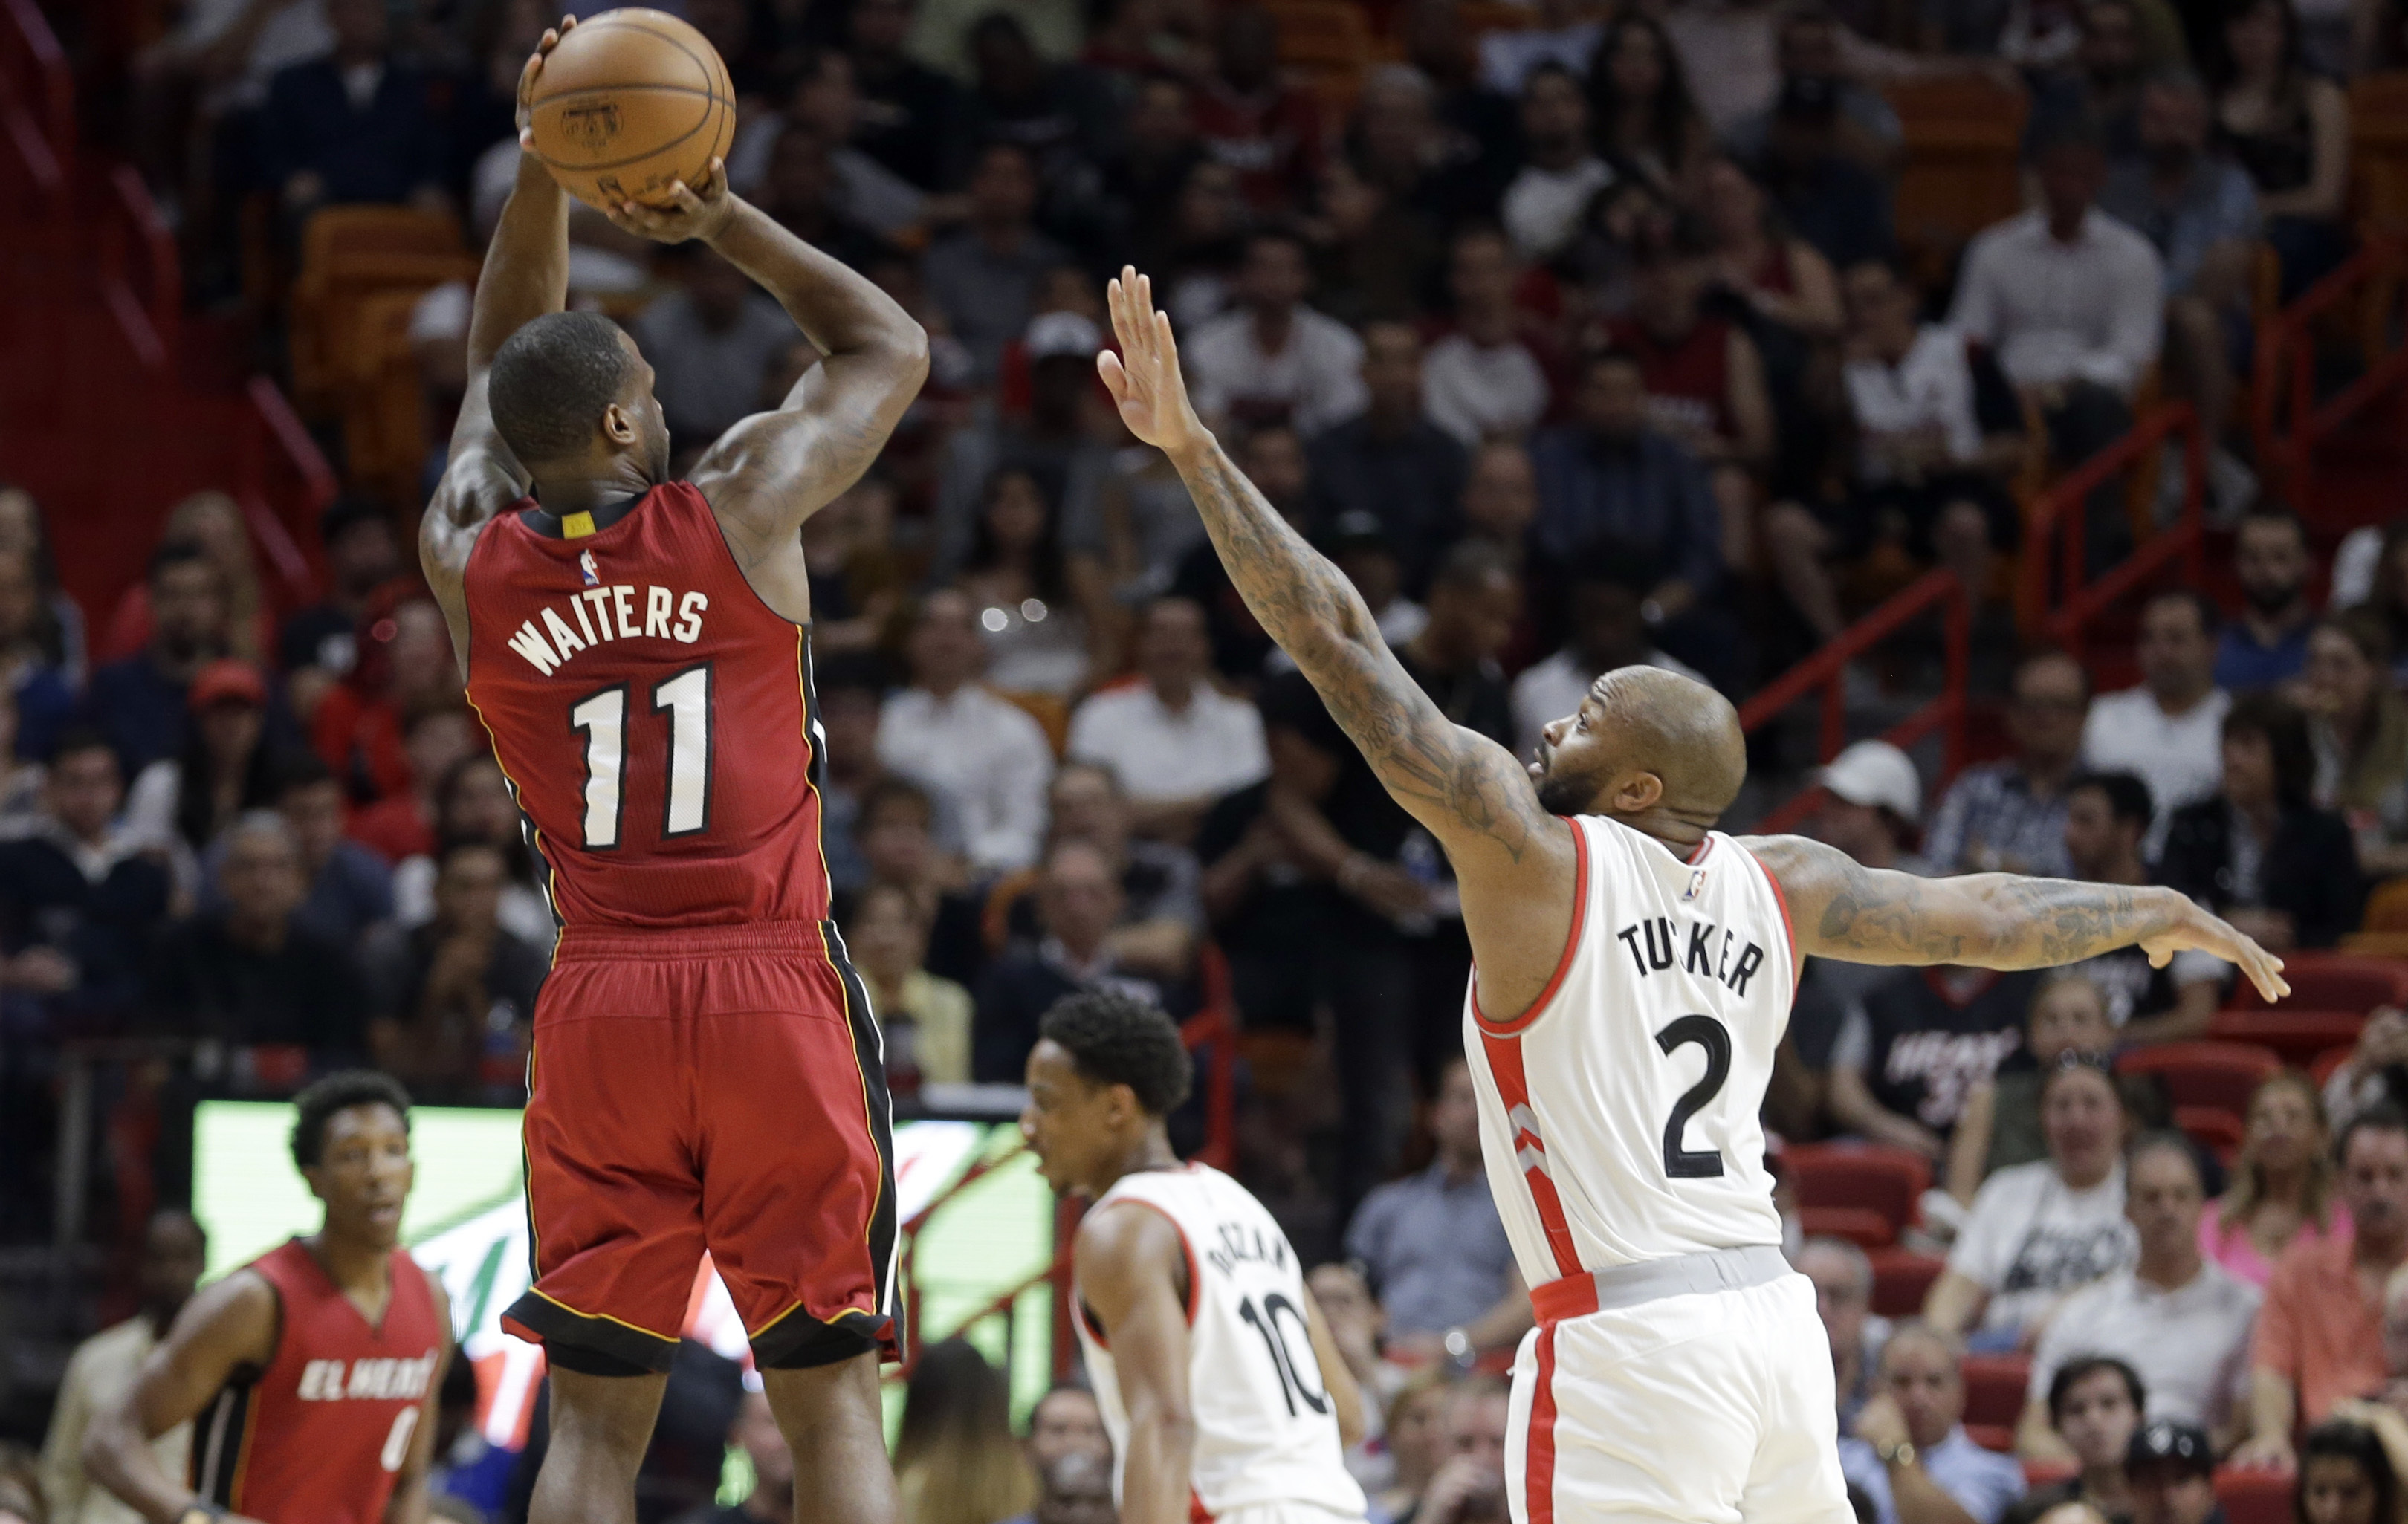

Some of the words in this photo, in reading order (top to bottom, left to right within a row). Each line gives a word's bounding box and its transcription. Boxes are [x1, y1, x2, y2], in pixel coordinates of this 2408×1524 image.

[508, 585, 708, 677] WAITERS
[569, 661, 711, 850] 11
[1617, 917, 1764, 999] TUKER
[1654, 1014, 1732, 1178] 2
[298, 1358, 346, 1401] EL
[1239, 1293, 1328, 1417] 10
